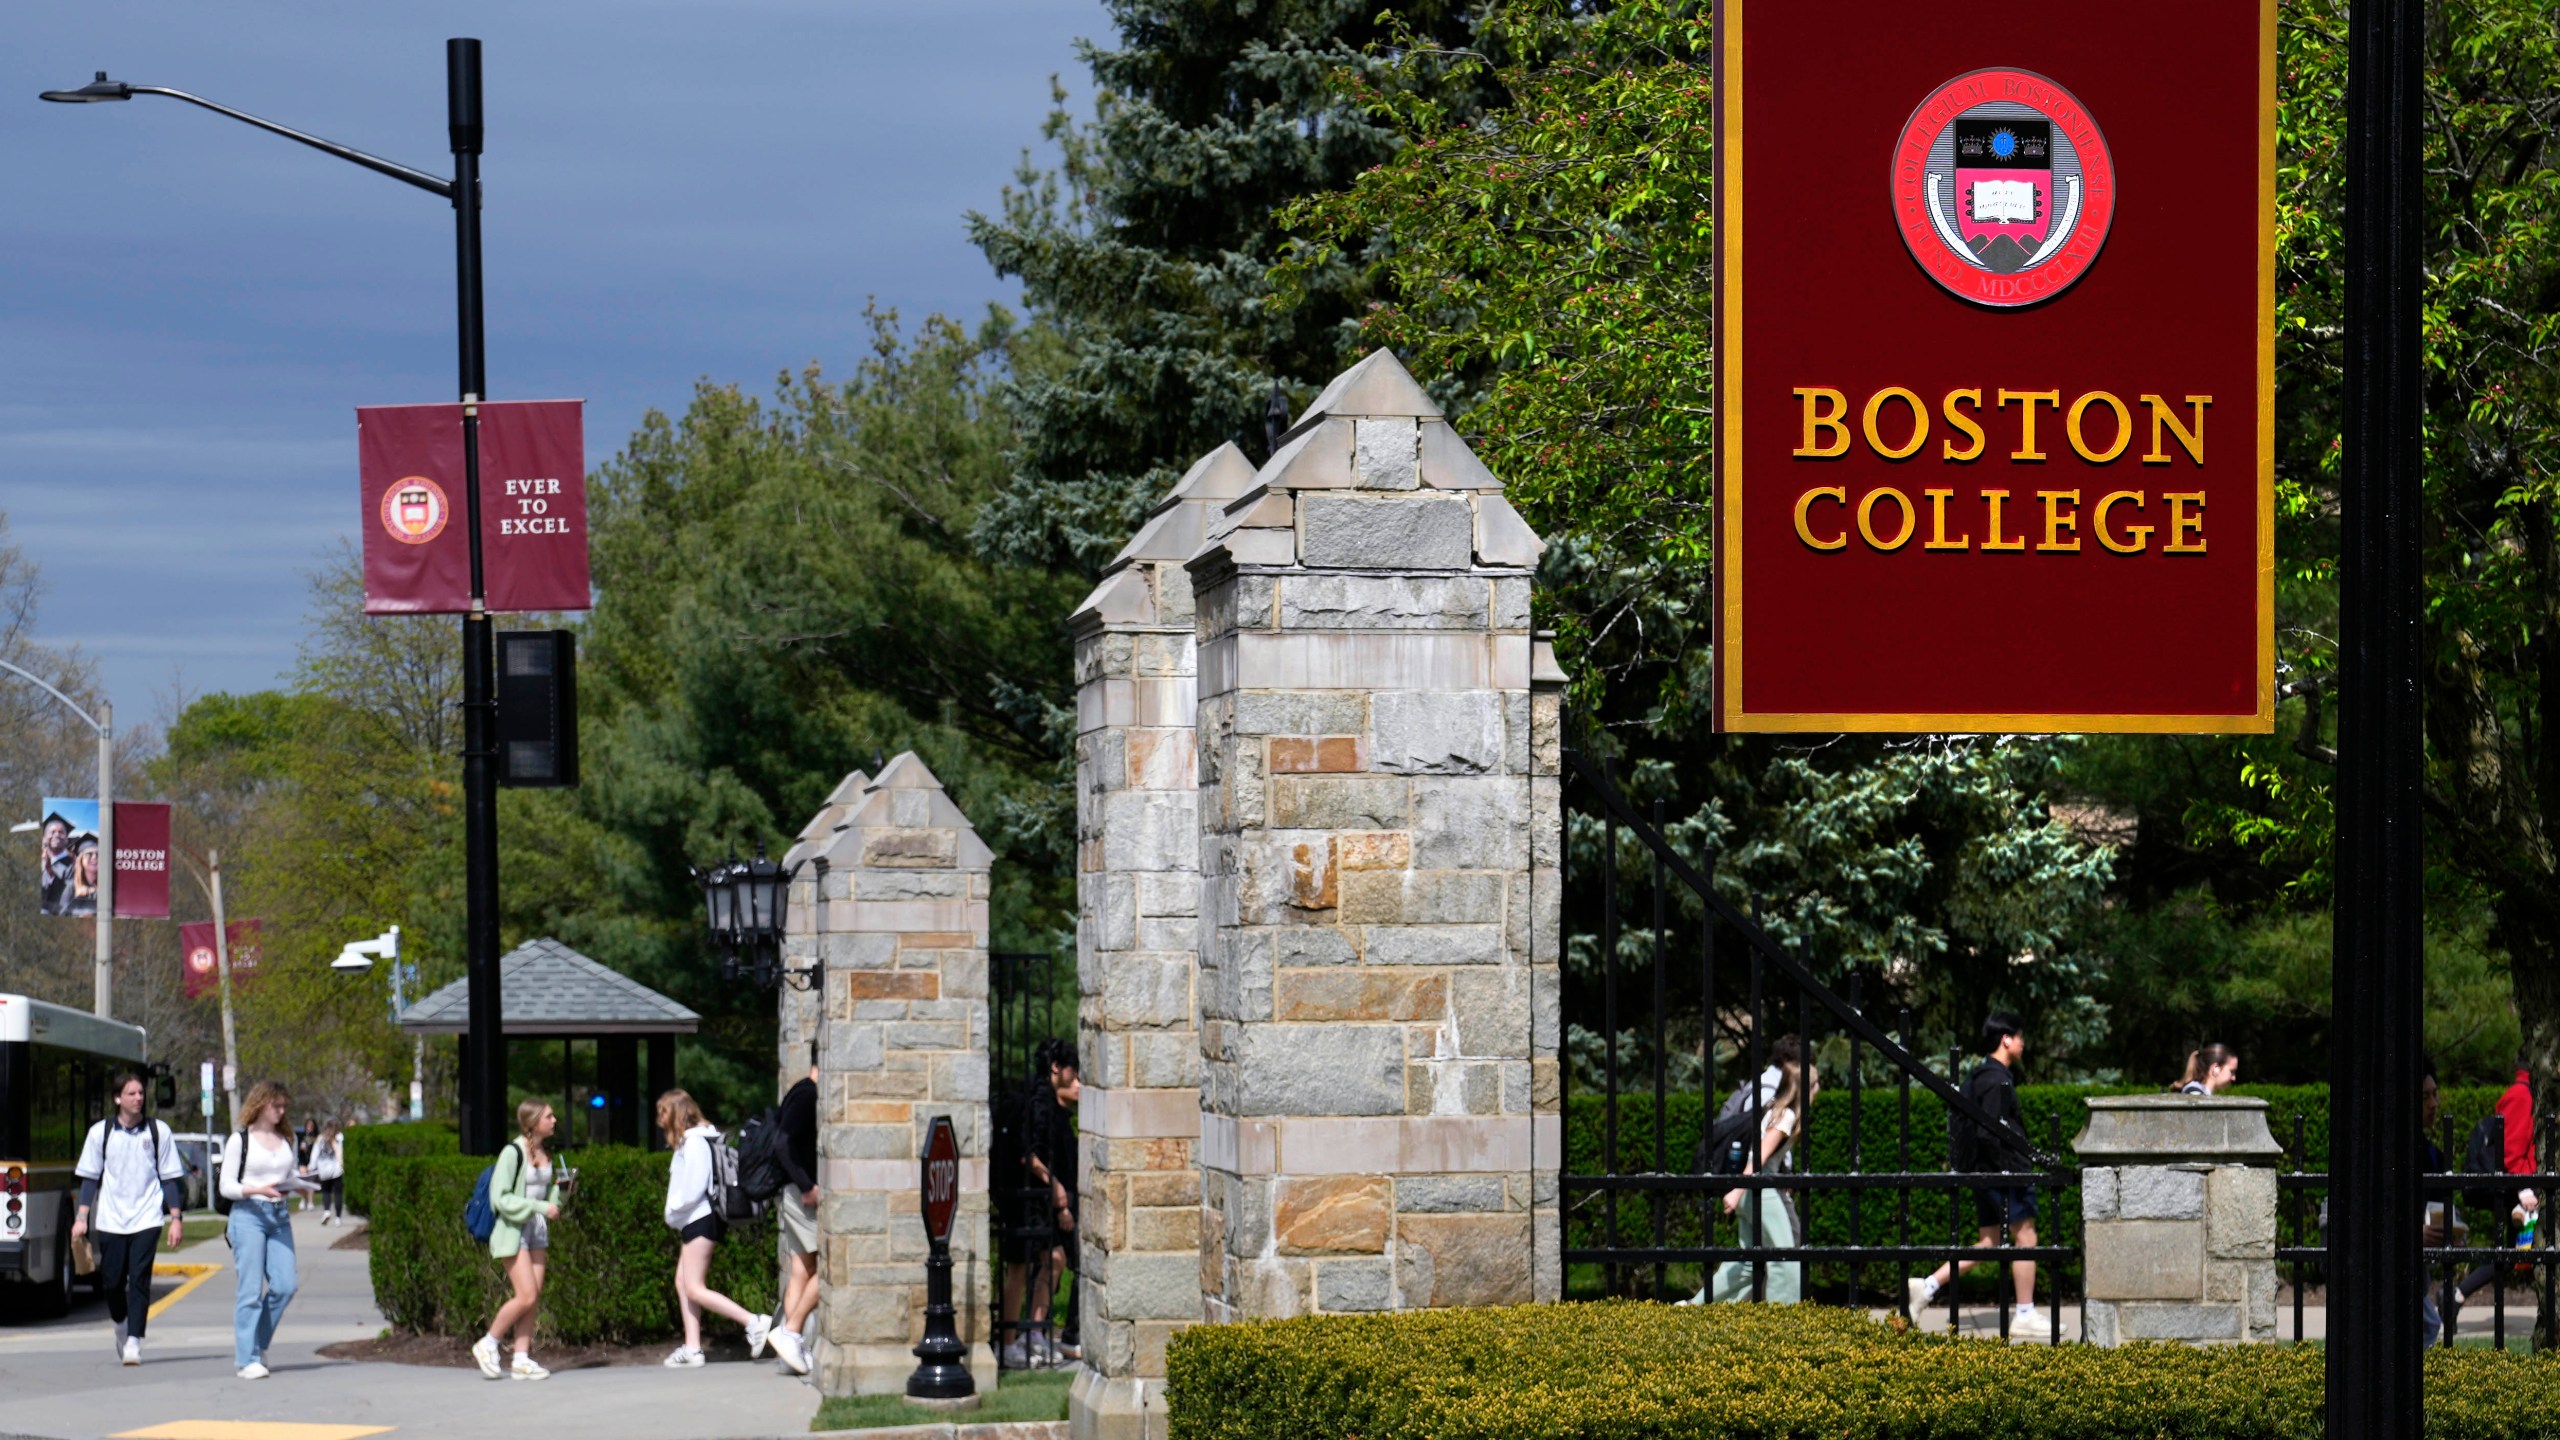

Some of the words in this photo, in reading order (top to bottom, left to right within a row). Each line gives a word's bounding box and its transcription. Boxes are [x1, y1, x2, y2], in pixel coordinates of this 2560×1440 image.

[1792, 386, 2213, 465] BOSTON
[505, 478, 562, 495] EVER
[517, 498, 548, 515] TO
[500, 517, 570, 535] EXCEL
[1793, 486, 2207, 554] COLLEGE
[115, 848, 166, 860] BOSTON
[115, 860, 166, 871] COLLEGE
[927, 1159, 955, 1203] STOP
